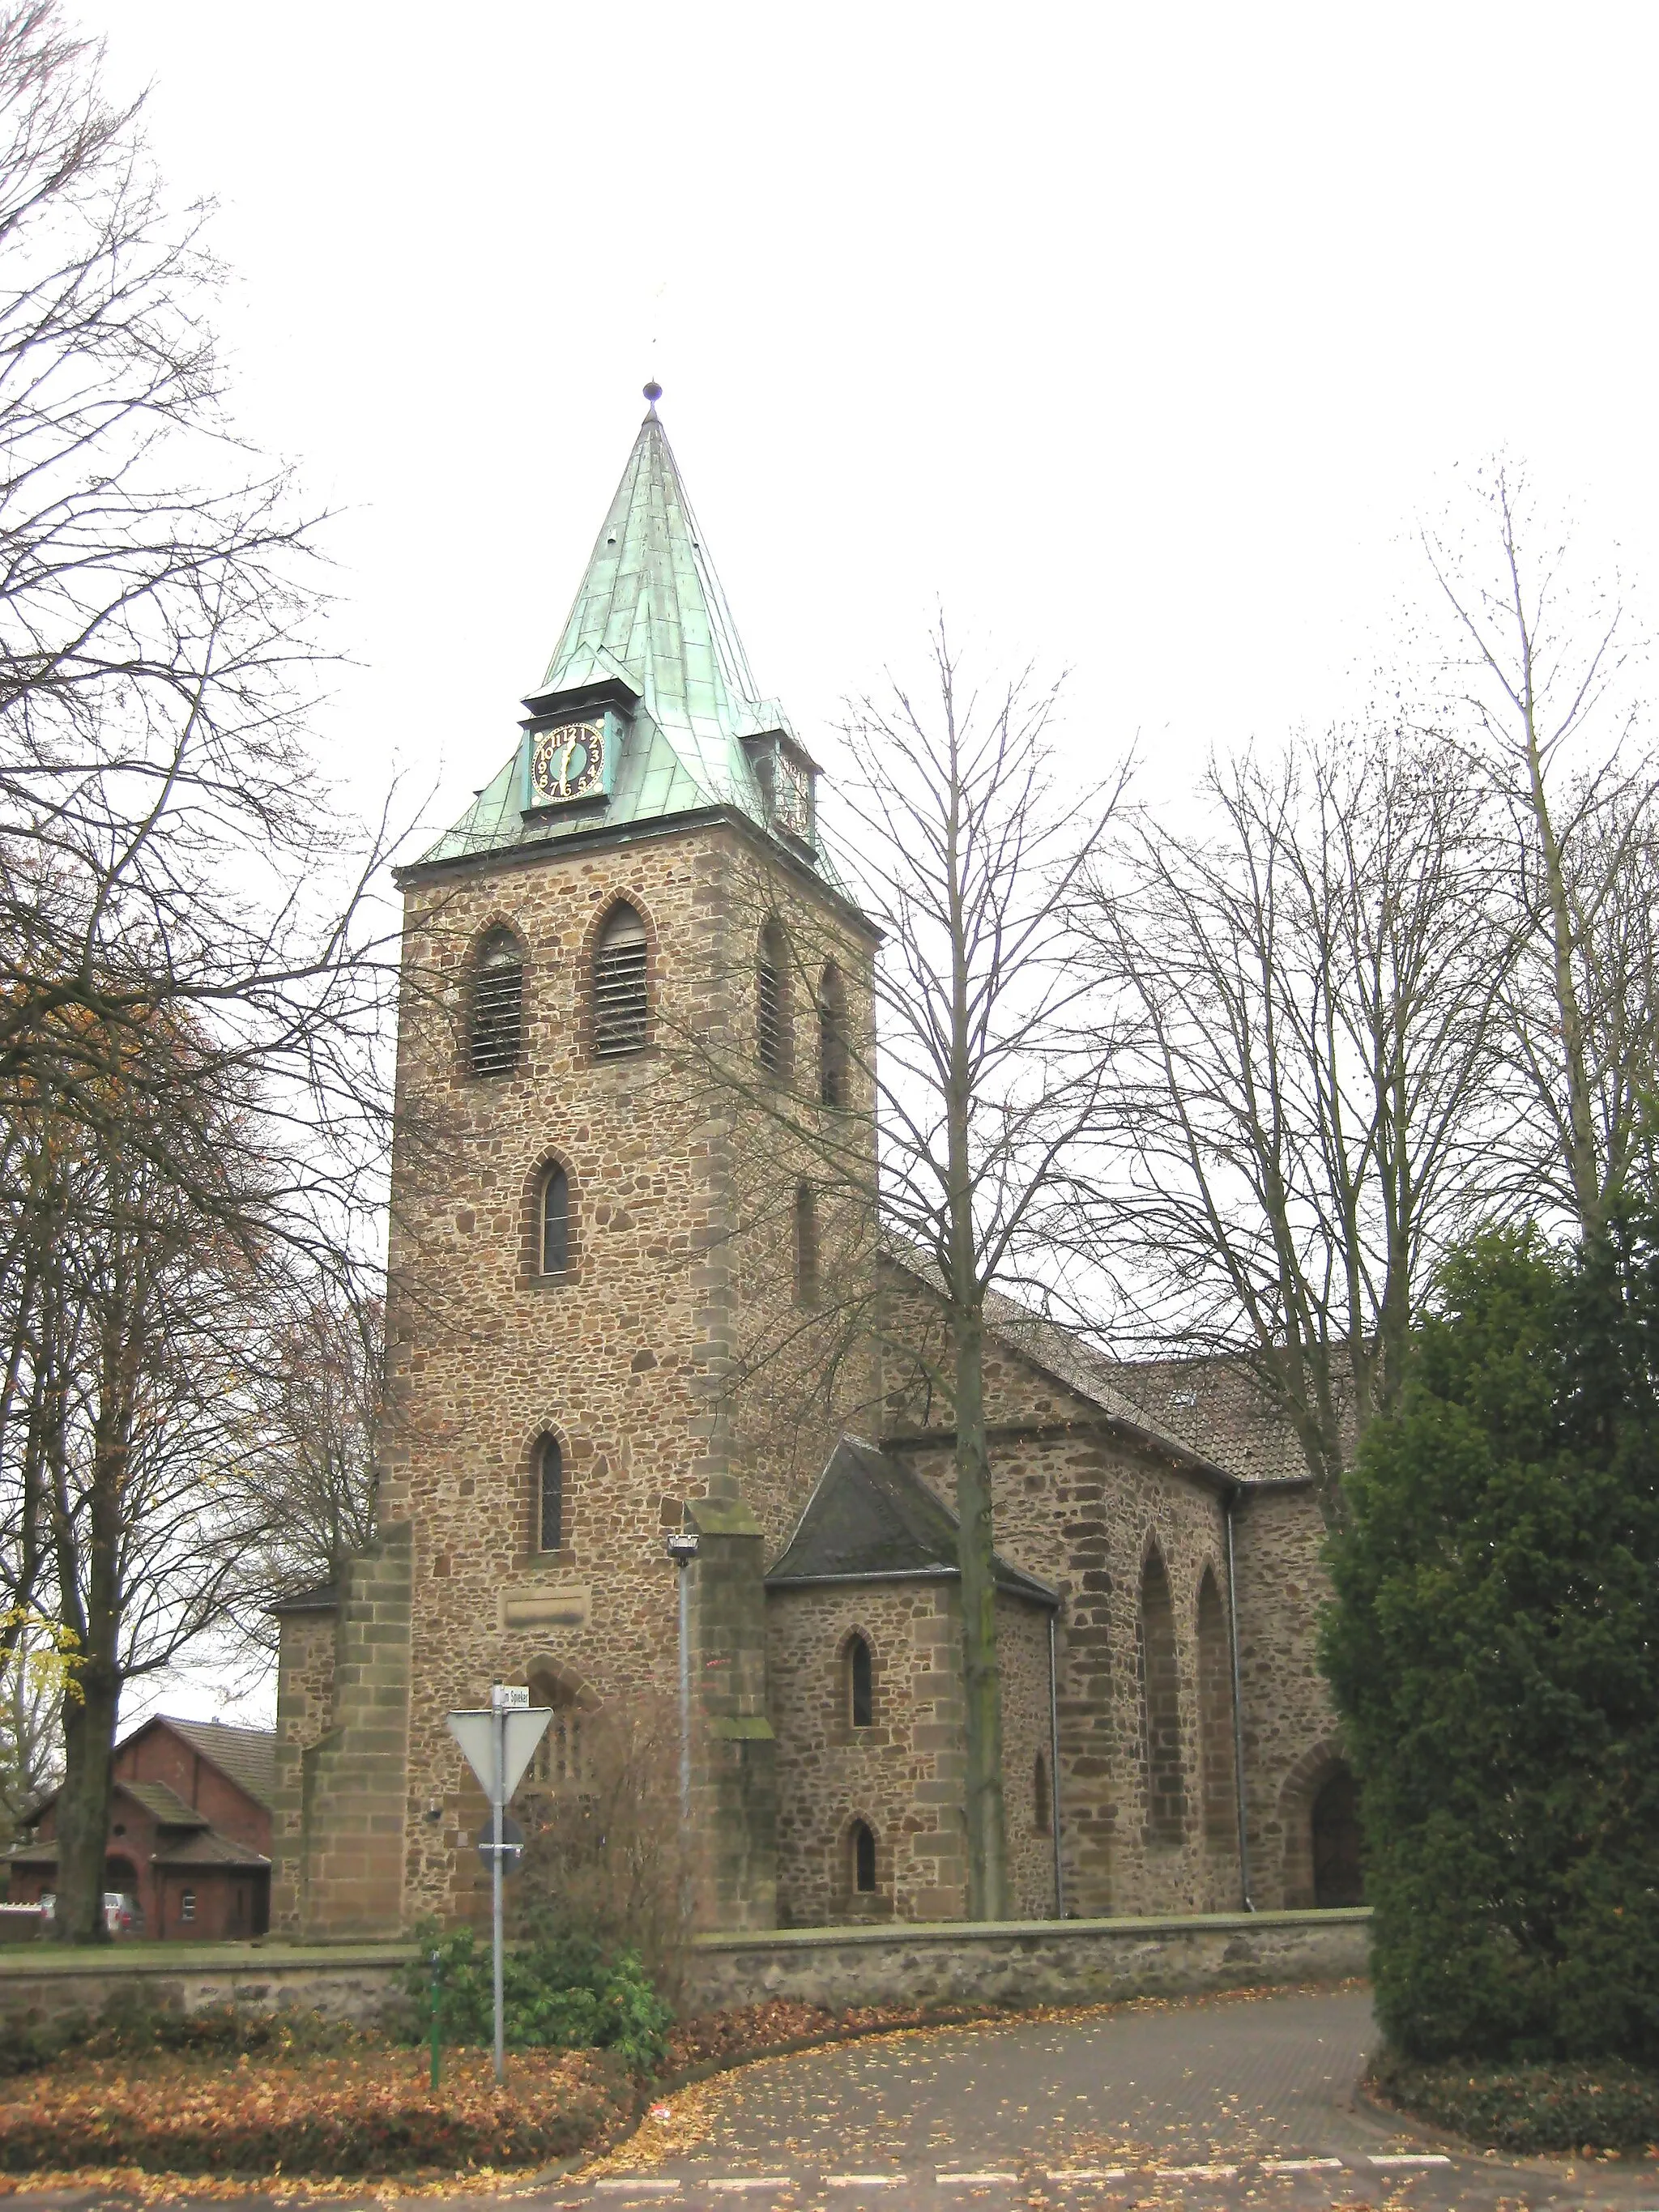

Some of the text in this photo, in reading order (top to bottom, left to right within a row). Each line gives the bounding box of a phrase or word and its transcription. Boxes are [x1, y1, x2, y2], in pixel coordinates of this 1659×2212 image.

[580, 728, 586, 740] 1
[551, 735, 561, 748] 11
[589, 735, 598, 749] 2
[540, 747, 553, 761] 10
[591, 750, 599, 763] 3
[538, 761, 547, 774] 9
[587, 765, 596, 778] 4
[539, 774, 548, 788] 8
[578, 777, 586, 790] 5
[549, 782, 559, 795] 7
[564, 783, 572, 796] 6
